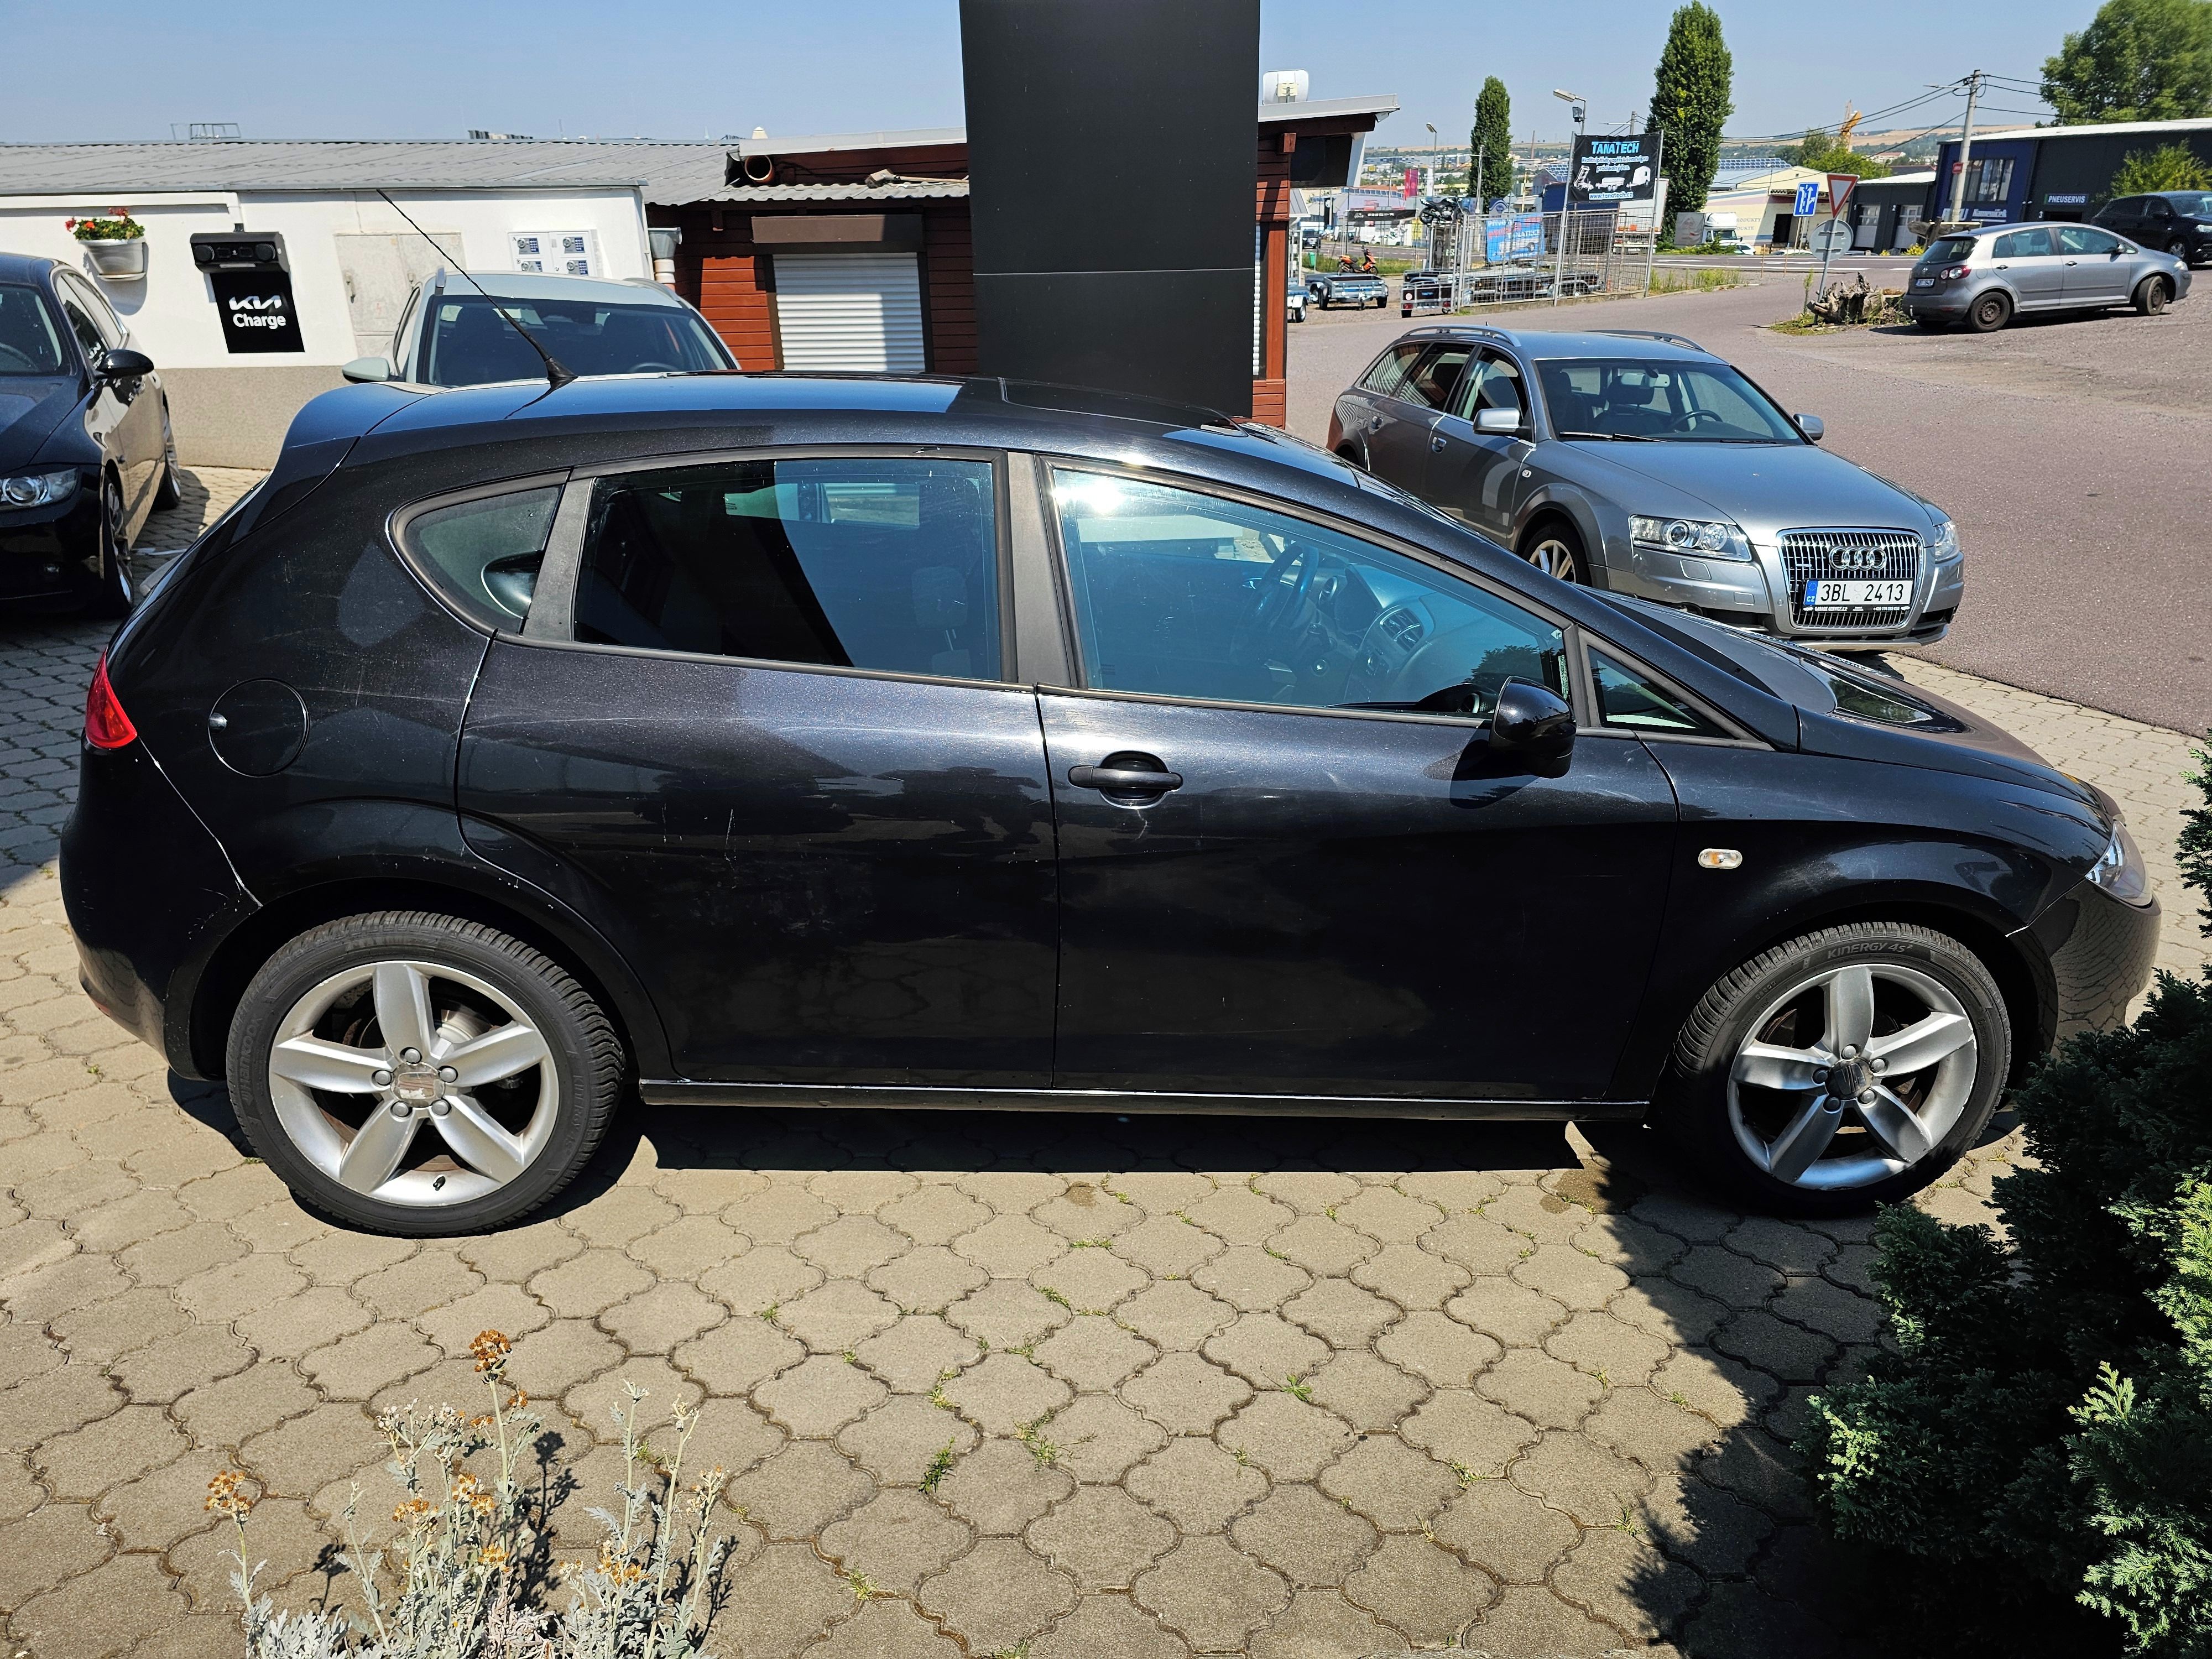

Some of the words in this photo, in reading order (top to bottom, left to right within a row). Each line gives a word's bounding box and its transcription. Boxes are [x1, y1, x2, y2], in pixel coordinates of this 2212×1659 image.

[1589, 191, 1633, 200] www.tanatech.cz
[2048, 195, 2086, 204] PNEUSERVIS
[229, 295, 282, 310] KIA
[233, 313, 286, 330] Charge
[1820, 583, 1850, 602] 3BL
[1864, 583, 1904, 602] 2413
[1828, 942, 1888, 959] KINERGY
